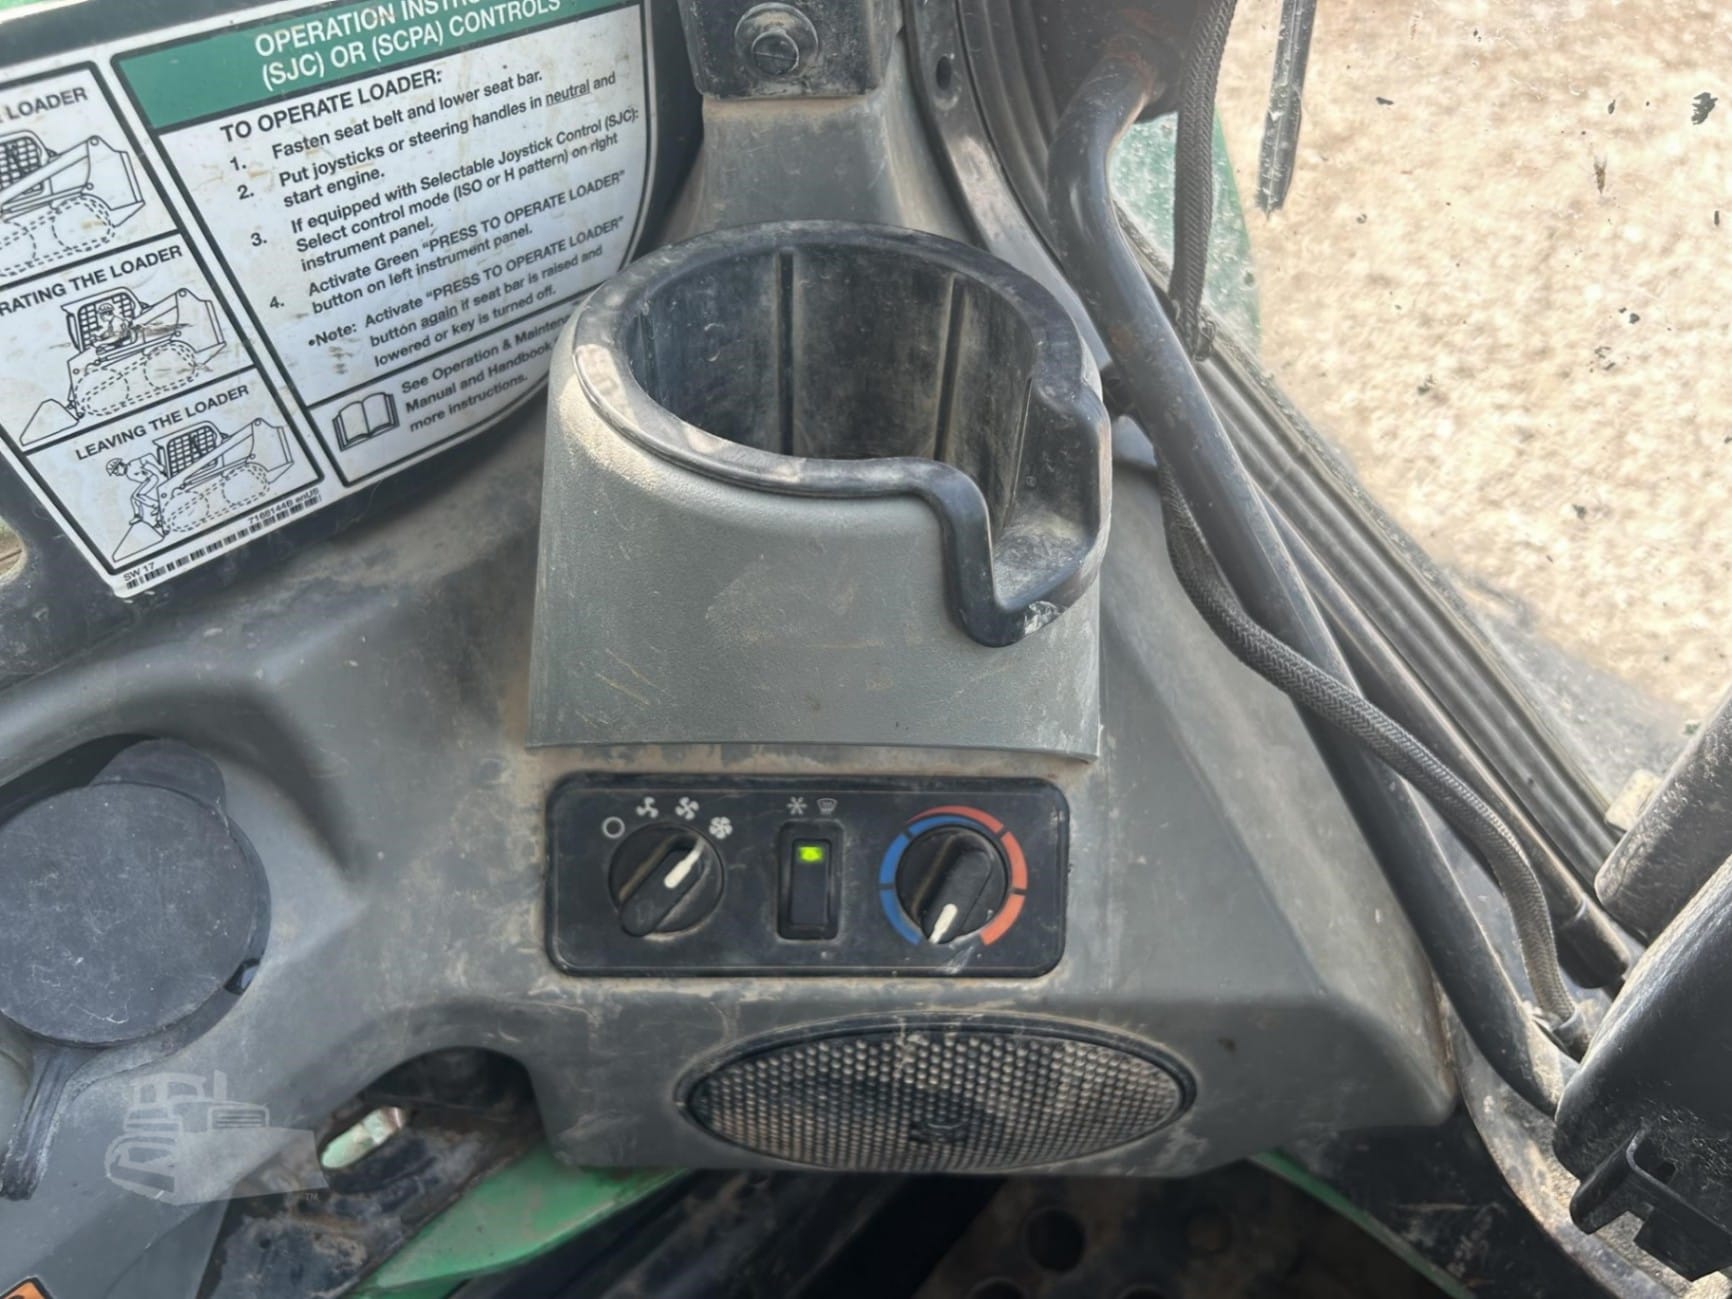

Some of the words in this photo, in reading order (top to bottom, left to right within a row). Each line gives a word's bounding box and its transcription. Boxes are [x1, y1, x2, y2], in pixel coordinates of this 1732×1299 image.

[255, 3, 396, 56] OPERATION
[263, 51, 324, 92] (SJC)
[330, 41, 366, 68] OR
[372, 20, 443, 62] (SCPA)
[449, 0, 561, 37] CONTROLS
[5, 87, 88, 120] LOADER
[220, 121, 251, 142] TO
[258, 92, 354, 132] OPERATE
[358, 68, 442, 105] LOADER:
[230, 157, 247, 171] 1.
[272, 132, 330, 159] Fasten
[334, 119, 371, 141] seat
[373, 109, 404, 130] belt
[407, 99, 436, 119] and
[439, 88, 480, 110] lower
[484, 76, 514, 97] seat
[517, 70, 543, 86] bar.
[237, 184, 254, 199] 2.
[279, 168, 310, 187] Put
[313, 144, 385, 179] joysticks
[388, 138, 405, 154] or
[408, 119, 469, 147] steering
[472, 102, 527, 128] handles
[529, 96, 542, 110] in
[546, 79, 590, 106] neutral
[593, 72, 616, 90] and
[251, 232, 267, 247] 3.
[291, 217, 303, 233] If
[307, 195, 381, 229] equipped
[384, 183, 417, 202] with
[420, 157, 494, 191] Selectable
[499, 138, 553, 164] Joystick
[556, 119, 602, 144] Control
[604, 107, 639, 131] (SJC):
[283, 185, 323, 207] start
[327, 168, 385, 194] engine.
[296, 226, 347, 252] Select
[351, 206, 405, 234] control
[409, 192, 449, 214] mode
[454, 180, 482, 202] (ISO
[487, 174, 500, 188] or
[504, 168, 515, 183] H
[518, 148, 568, 179] pattern)
[572, 145, 588, 158] on
[590, 133, 618, 154] right
[69, 269, 107, 291] THE
[109, 245, 183, 278] LOADER
[269, 296, 285, 309] 4.
[308, 264, 371, 296] Activate
[374, 249, 419, 271] Green
[481, 216, 501, 233] TO
[504, 193, 566, 223] OPERATE
[301, 233, 387, 272] instrument
[389, 216, 434, 243] panel.
[312, 288, 363, 314] button
[367, 280, 386, 294] on
[389, 268, 413, 286] left
[416, 243, 491, 276] instrument
[493, 223, 533, 247] panel.
[365, 298, 423, 328] Activate
[483, 261, 502, 280] TO
[506, 240, 567, 272] OPERATE
[370, 322, 417, 347] button
[420, 307, 459, 330] again
[461, 297, 470, 311] if
[473, 288, 502, 307] seat
[504, 279, 525, 294] bar
[528, 273, 539, 284] is
[542, 257, 578, 278] raised
[582, 246, 603, 262] and
[374, 336, 431, 367] lowered
[434, 330, 449, 343] or
[452, 319, 475, 337] key
[478, 312, 490, 325] is
[493, 293, 534, 319] turned
[401, 375, 429, 395] See
[432, 344, 499, 381] Operation
[405, 384, 457, 414] Manual
[460, 373, 485, 389] and
[488, 341, 552, 377] Handbook
[410, 406, 445, 432] more
[449, 373, 528, 415] instructions.
[75, 425, 147, 460] LEAVING
[148, 409, 183, 431] THE
[185, 384, 249, 418] LOADER
